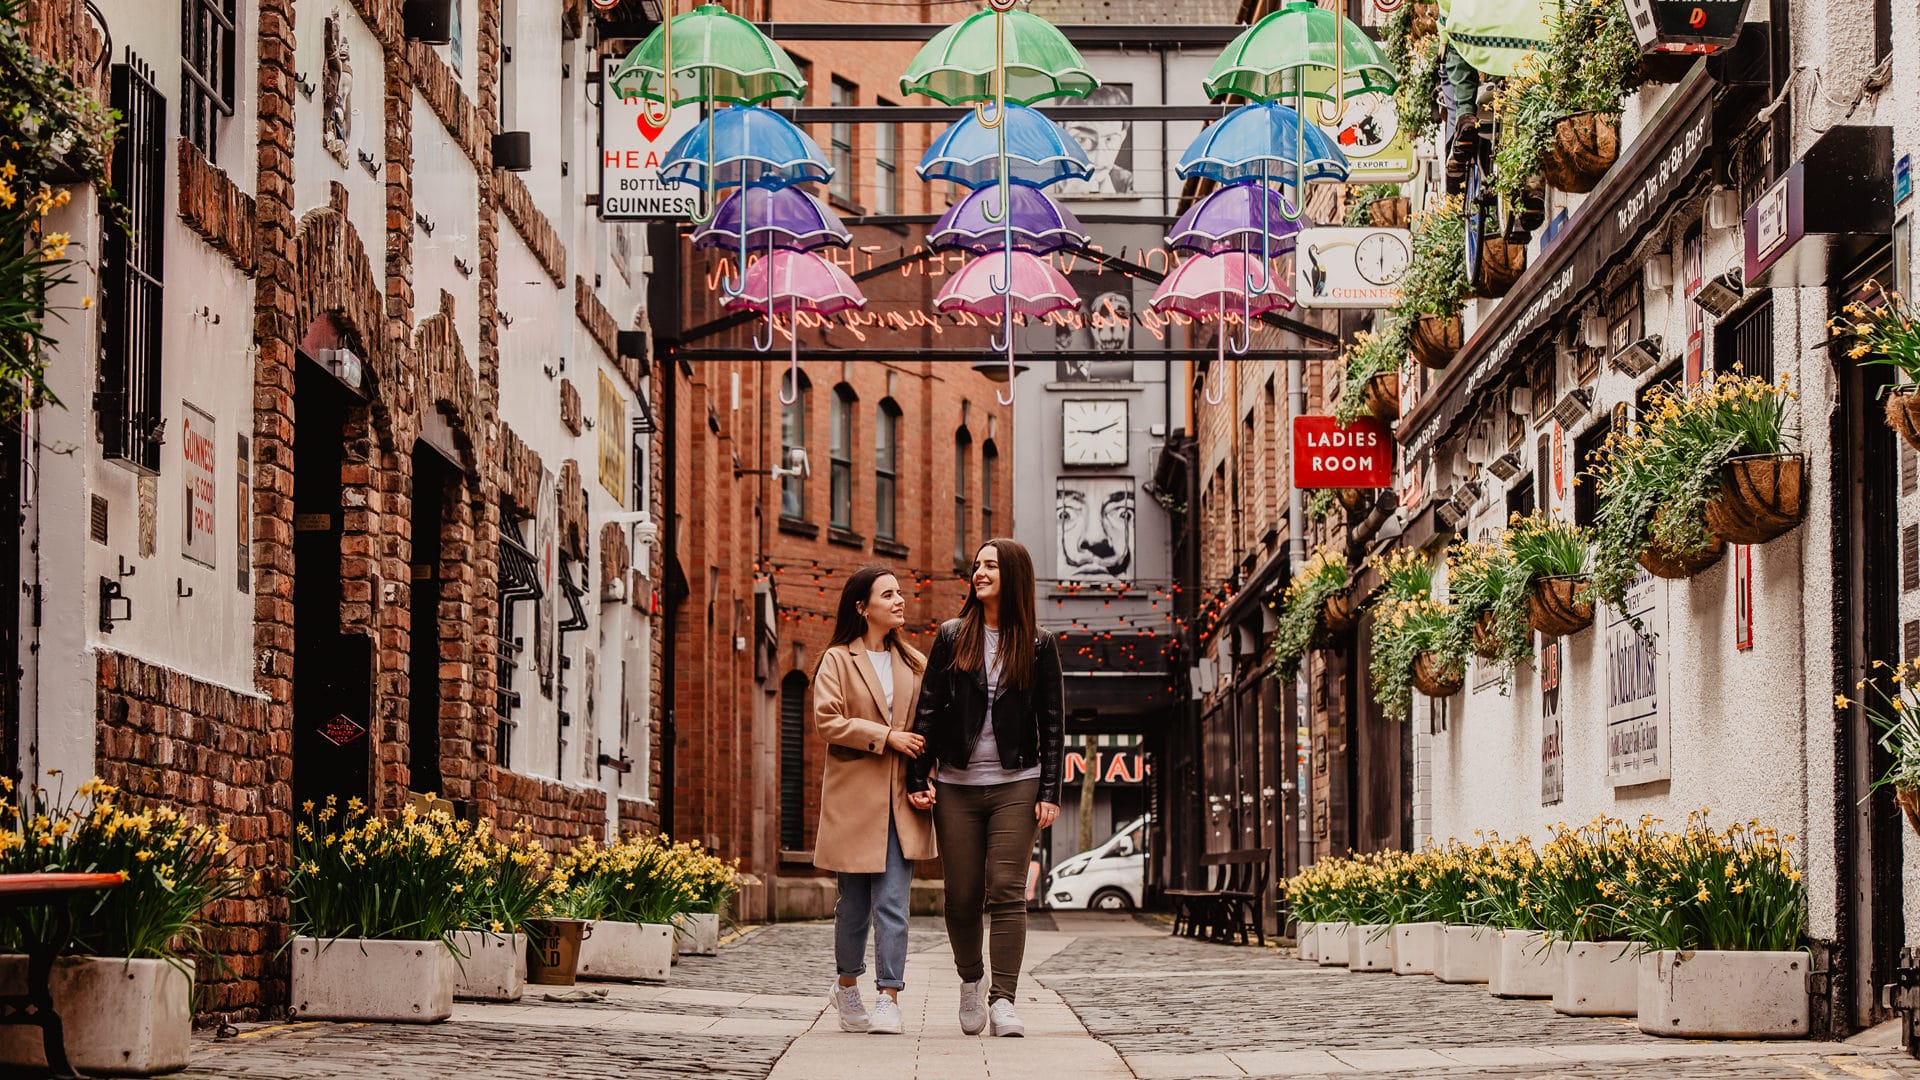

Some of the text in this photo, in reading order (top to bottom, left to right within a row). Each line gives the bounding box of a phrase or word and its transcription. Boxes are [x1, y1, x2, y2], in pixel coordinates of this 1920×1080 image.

[605, 151, 697, 168] HEA
[620, 179, 681, 191] BOTTLED
[606, 197, 696, 213] GUINNESS
[1331, 287, 1405, 299] GUINNES
[183, 418, 214, 474] GUINNESS
[1307, 431, 1378, 448] LADIES
[1312, 455, 1374, 472] ROOM
[195, 476, 213, 504] IS GOOD
[194, 506, 214, 535] FOR YOU
